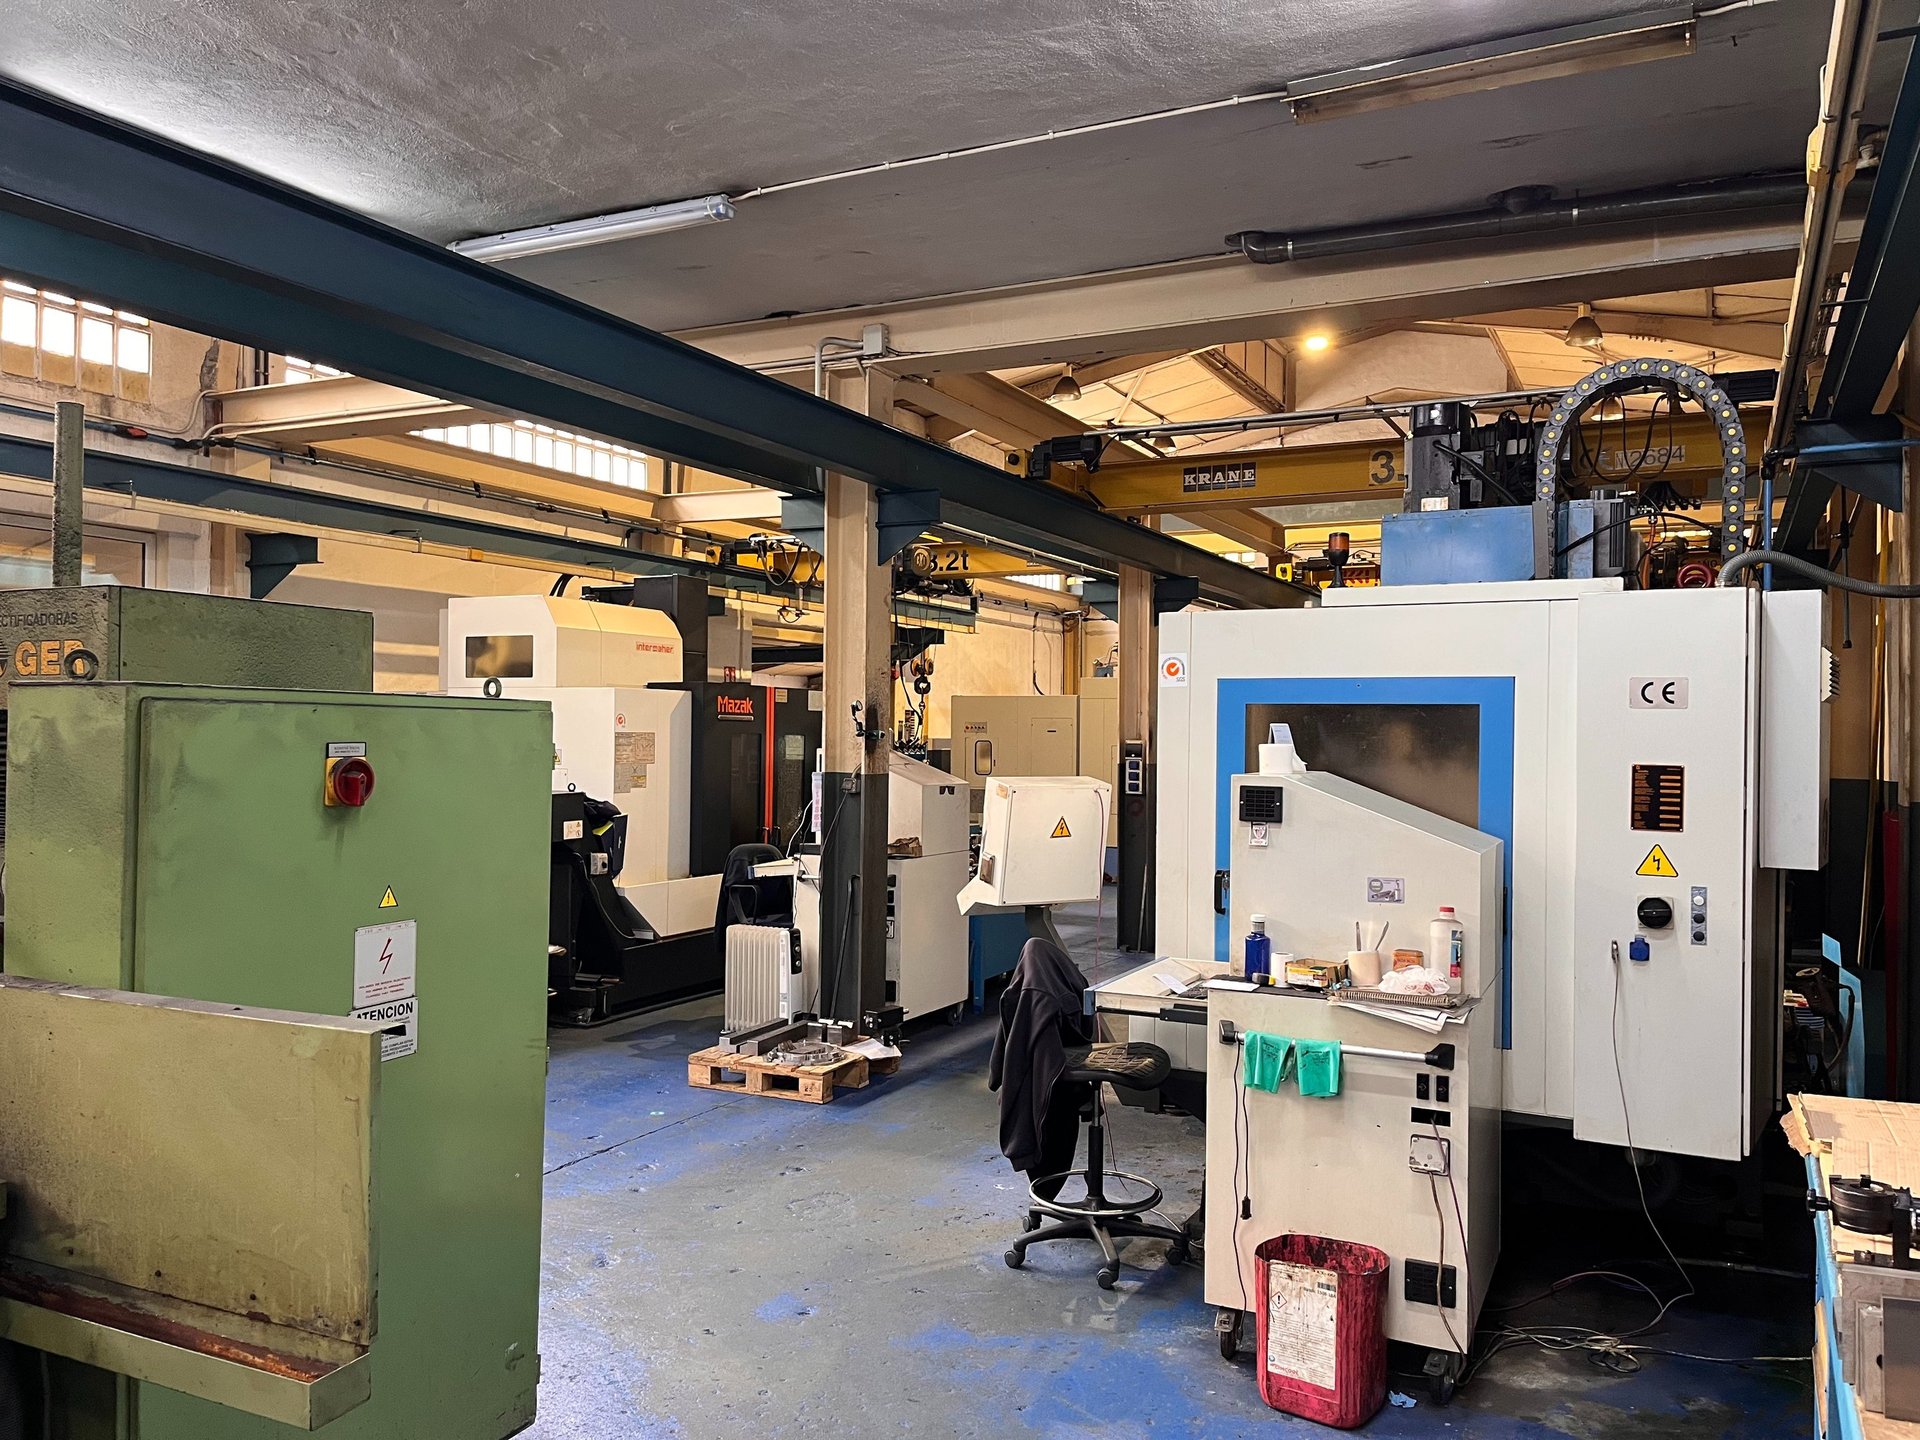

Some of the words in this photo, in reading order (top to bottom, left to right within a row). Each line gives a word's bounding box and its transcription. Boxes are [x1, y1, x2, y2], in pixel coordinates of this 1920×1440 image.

[1184, 469, 1256, 486] KRANE
[0, 612, 78, 627] CTIFICADORAS
[1641, 681, 1676, 705] CE
[717, 695, 754, 714] Mazak
